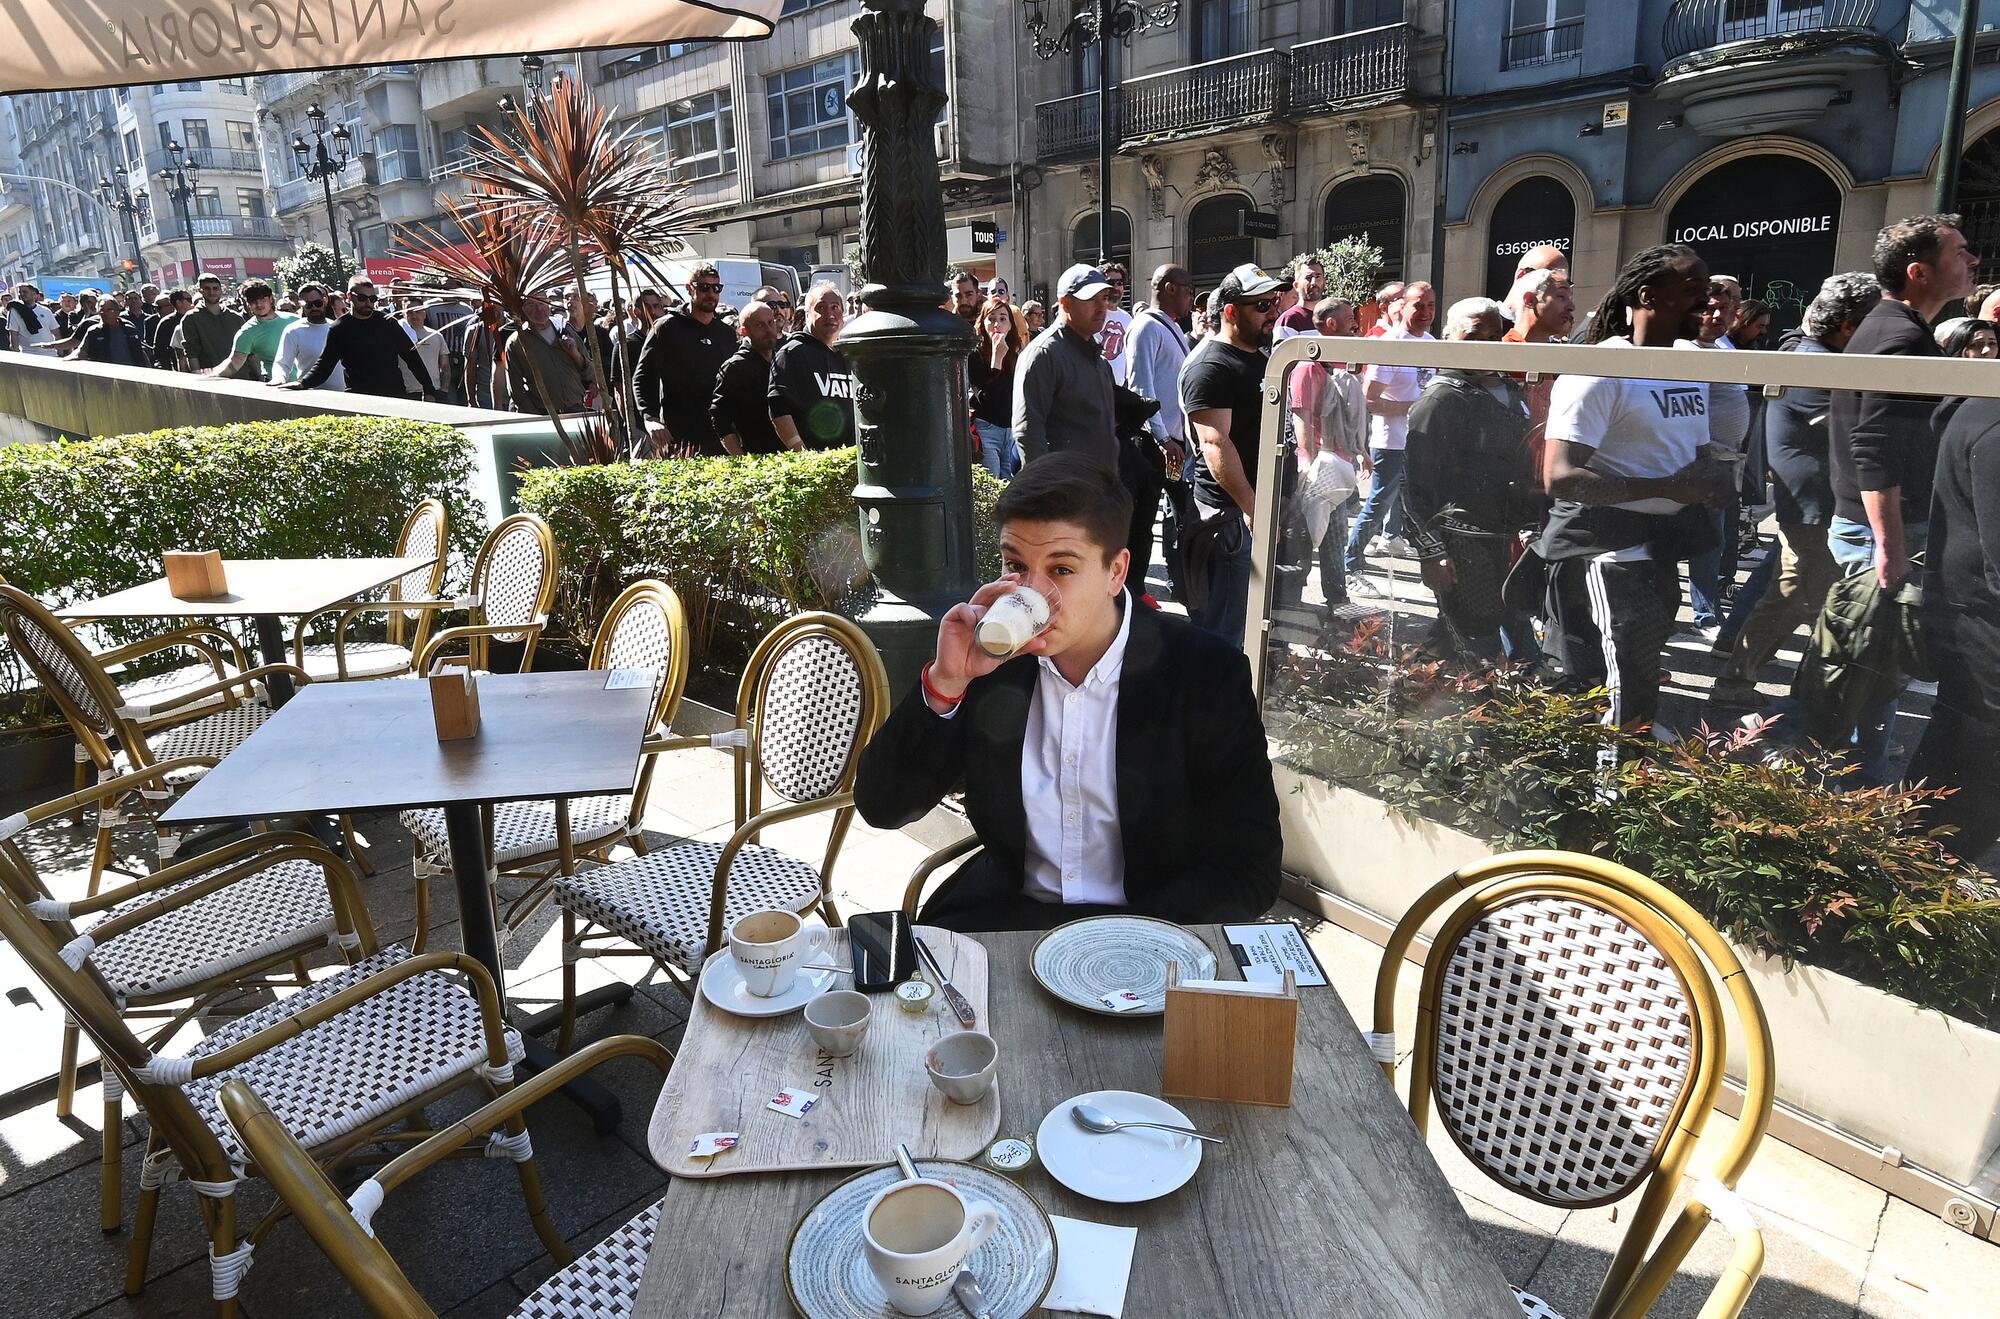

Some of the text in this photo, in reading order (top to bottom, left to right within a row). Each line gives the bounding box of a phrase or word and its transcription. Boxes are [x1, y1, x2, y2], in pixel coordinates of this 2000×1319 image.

[974, 231, 994, 243] TOUS
[1675, 216, 1831, 243] LOCAL DISPONIBLE
[813, 371, 854, 399] VAN
[1649, 387, 1705, 418] VANS
[740, 952, 794, 965] SANTAGLORIA
[895, 1250, 968, 1285] SANTAGLORIA
